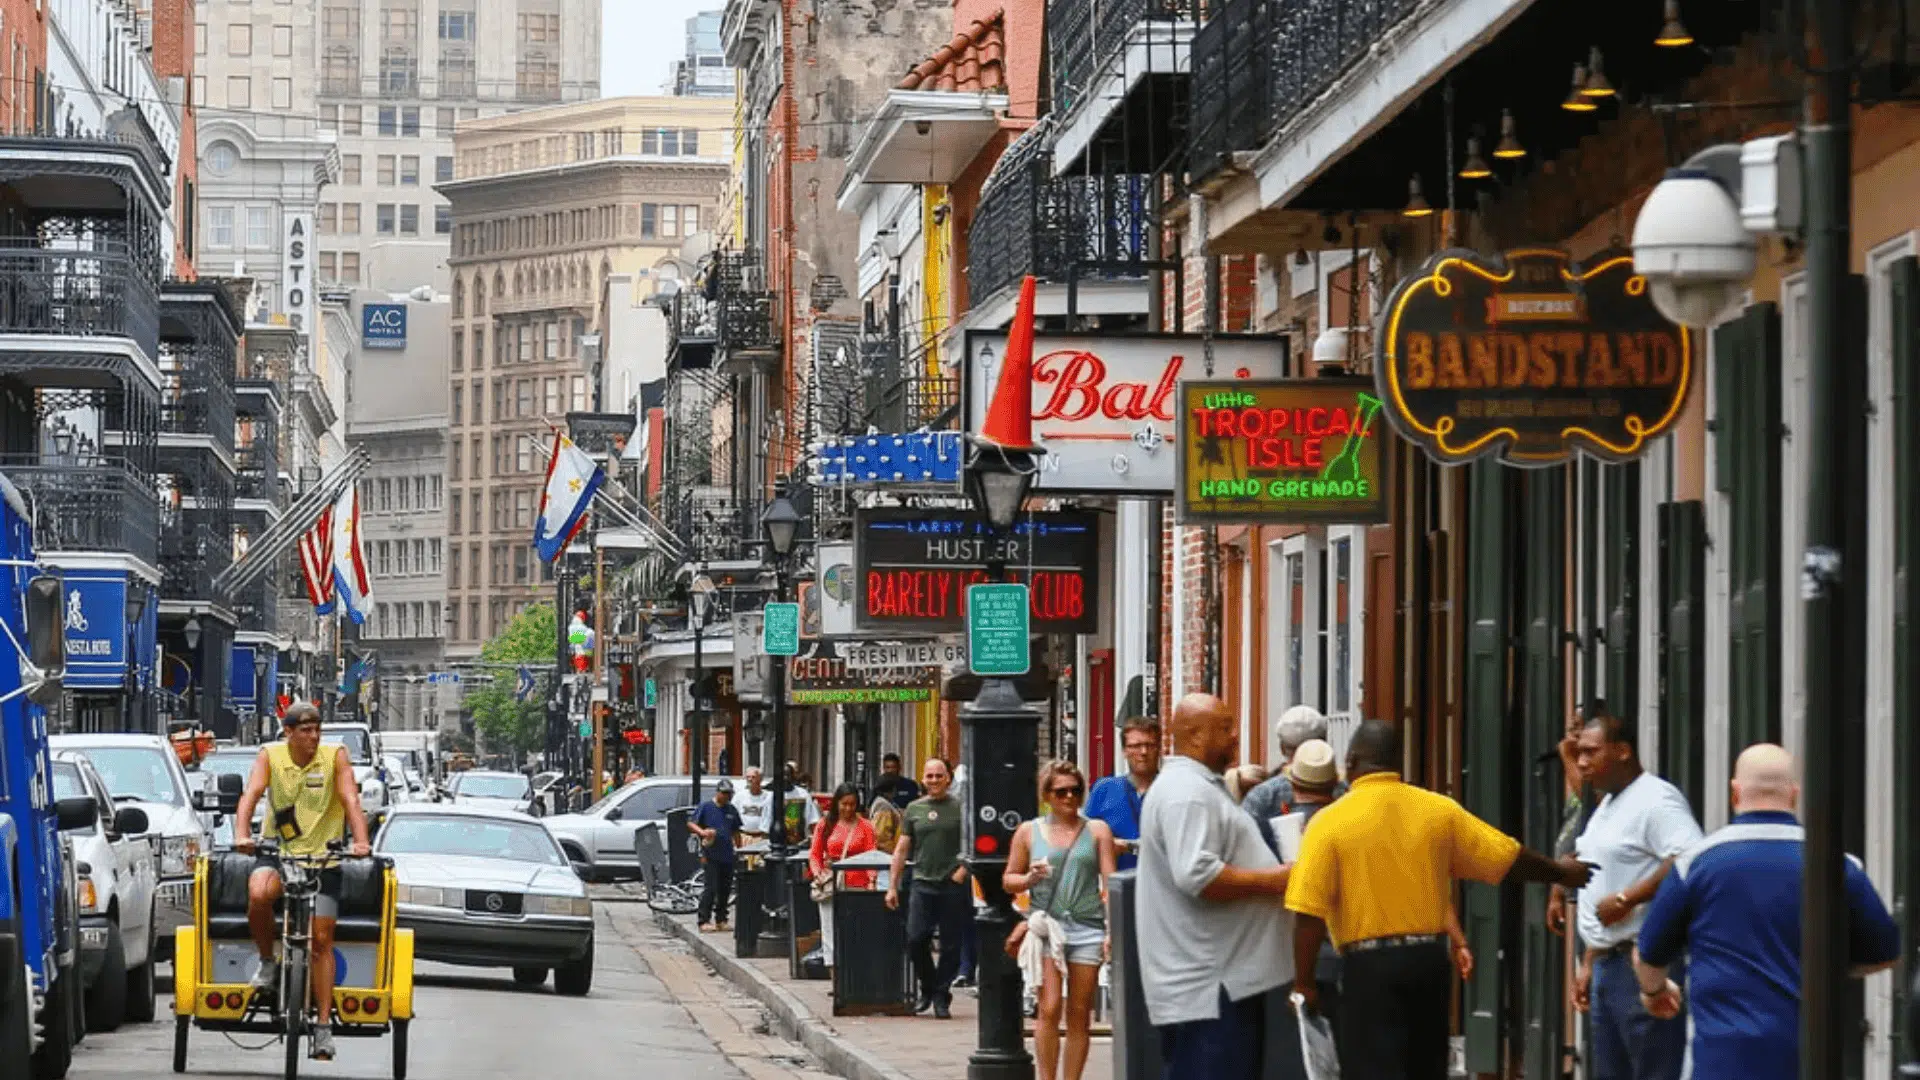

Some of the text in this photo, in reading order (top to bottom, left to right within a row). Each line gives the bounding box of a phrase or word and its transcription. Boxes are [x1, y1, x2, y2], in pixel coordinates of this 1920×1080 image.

[370, 310, 401, 327] AC
[1407, 331, 1678, 388] BANDSTAND
[1203, 392, 1257, 410] Little
[1193, 407, 1372, 438] TROPICAL
[1247, 439, 1323, 468] ISLE
[1201, 479, 1370, 498] HAND GRENADE
[907, 521, 964, 533] LARRY
[926, 539, 1019, 560] HUSTER
[868, 571, 1084, 618] BARELY CLUB
[850, 648, 898, 664] FRESH
[905, 647, 938, 662] MEX
